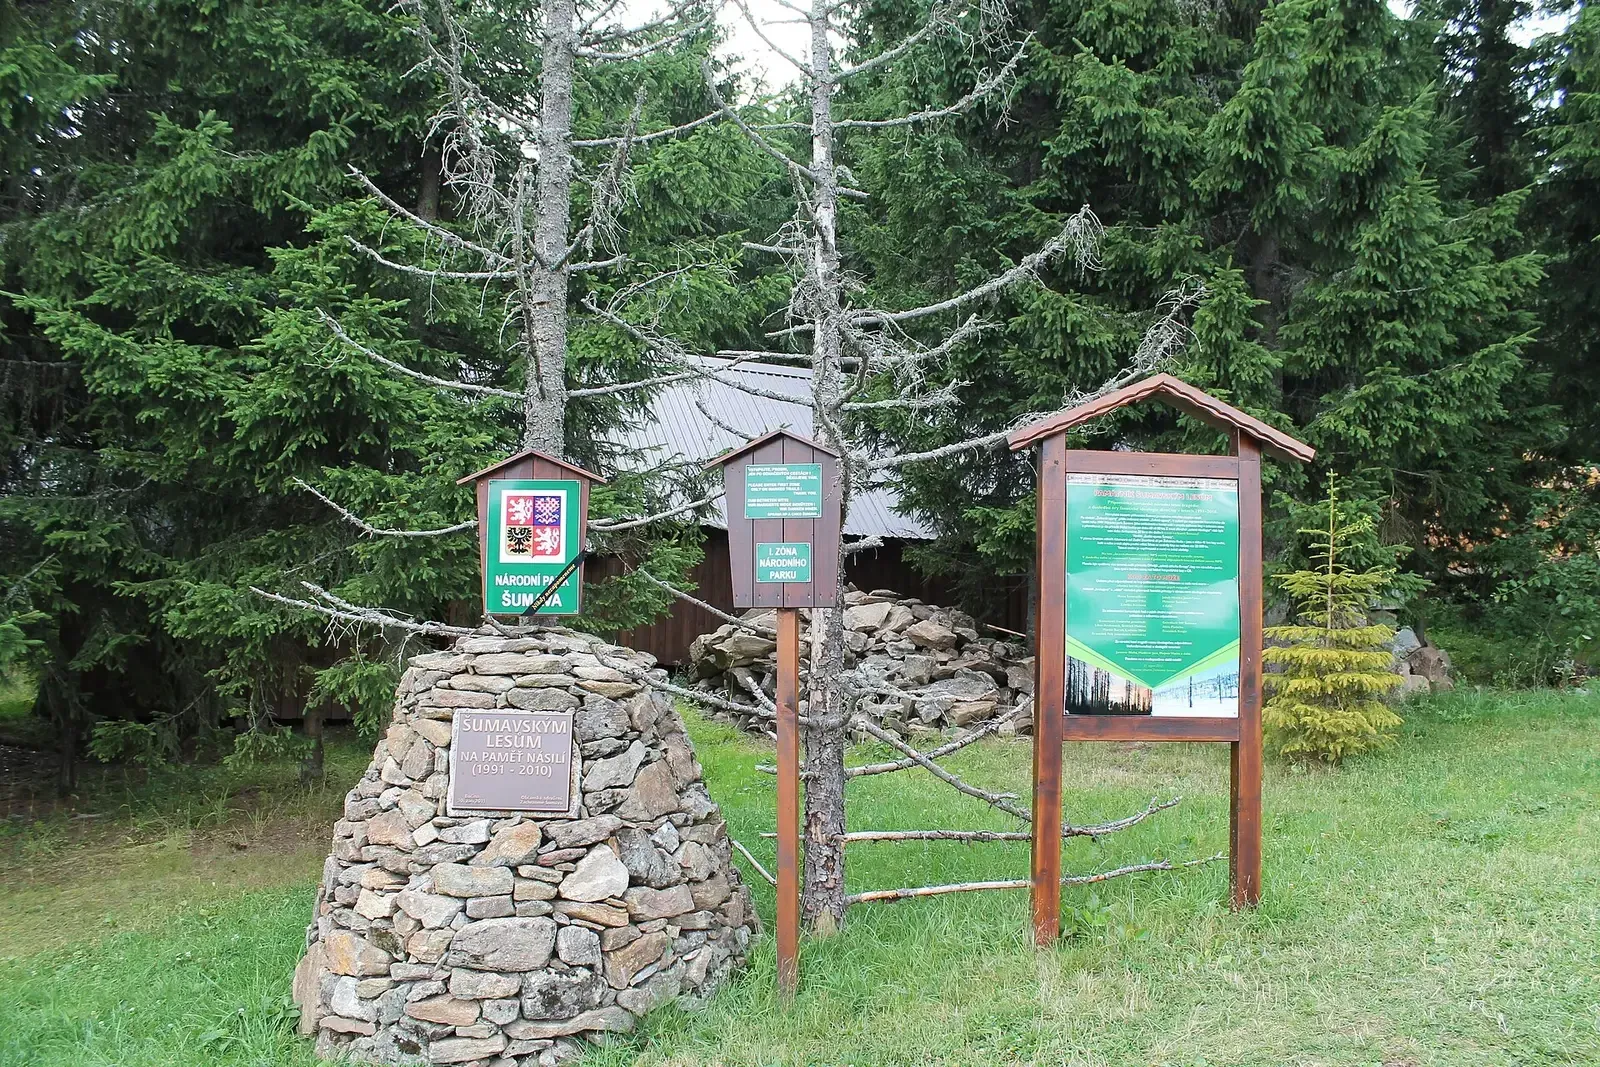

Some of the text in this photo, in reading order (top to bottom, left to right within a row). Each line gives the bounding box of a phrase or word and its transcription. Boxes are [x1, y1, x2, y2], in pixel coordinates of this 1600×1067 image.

[775, 546, 798, 556] ZÓNA
[760, 557, 807, 567] NÁRODNÍHO
[495, 573, 569, 586] NÁRODNÍ PAK
[770, 571, 797, 579] PARKU
[502, 590, 562, 607] ŠUMVA
[462, 714, 567, 734] ŠUMAVSKÝM
[486, 731, 542, 748] LESŮM
[460, 750, 566, 764] NA PAMĚŤ NÁSILÍ
[472, 764, 504, 776] (1991
[519, 765, 552, 777] 2010)
